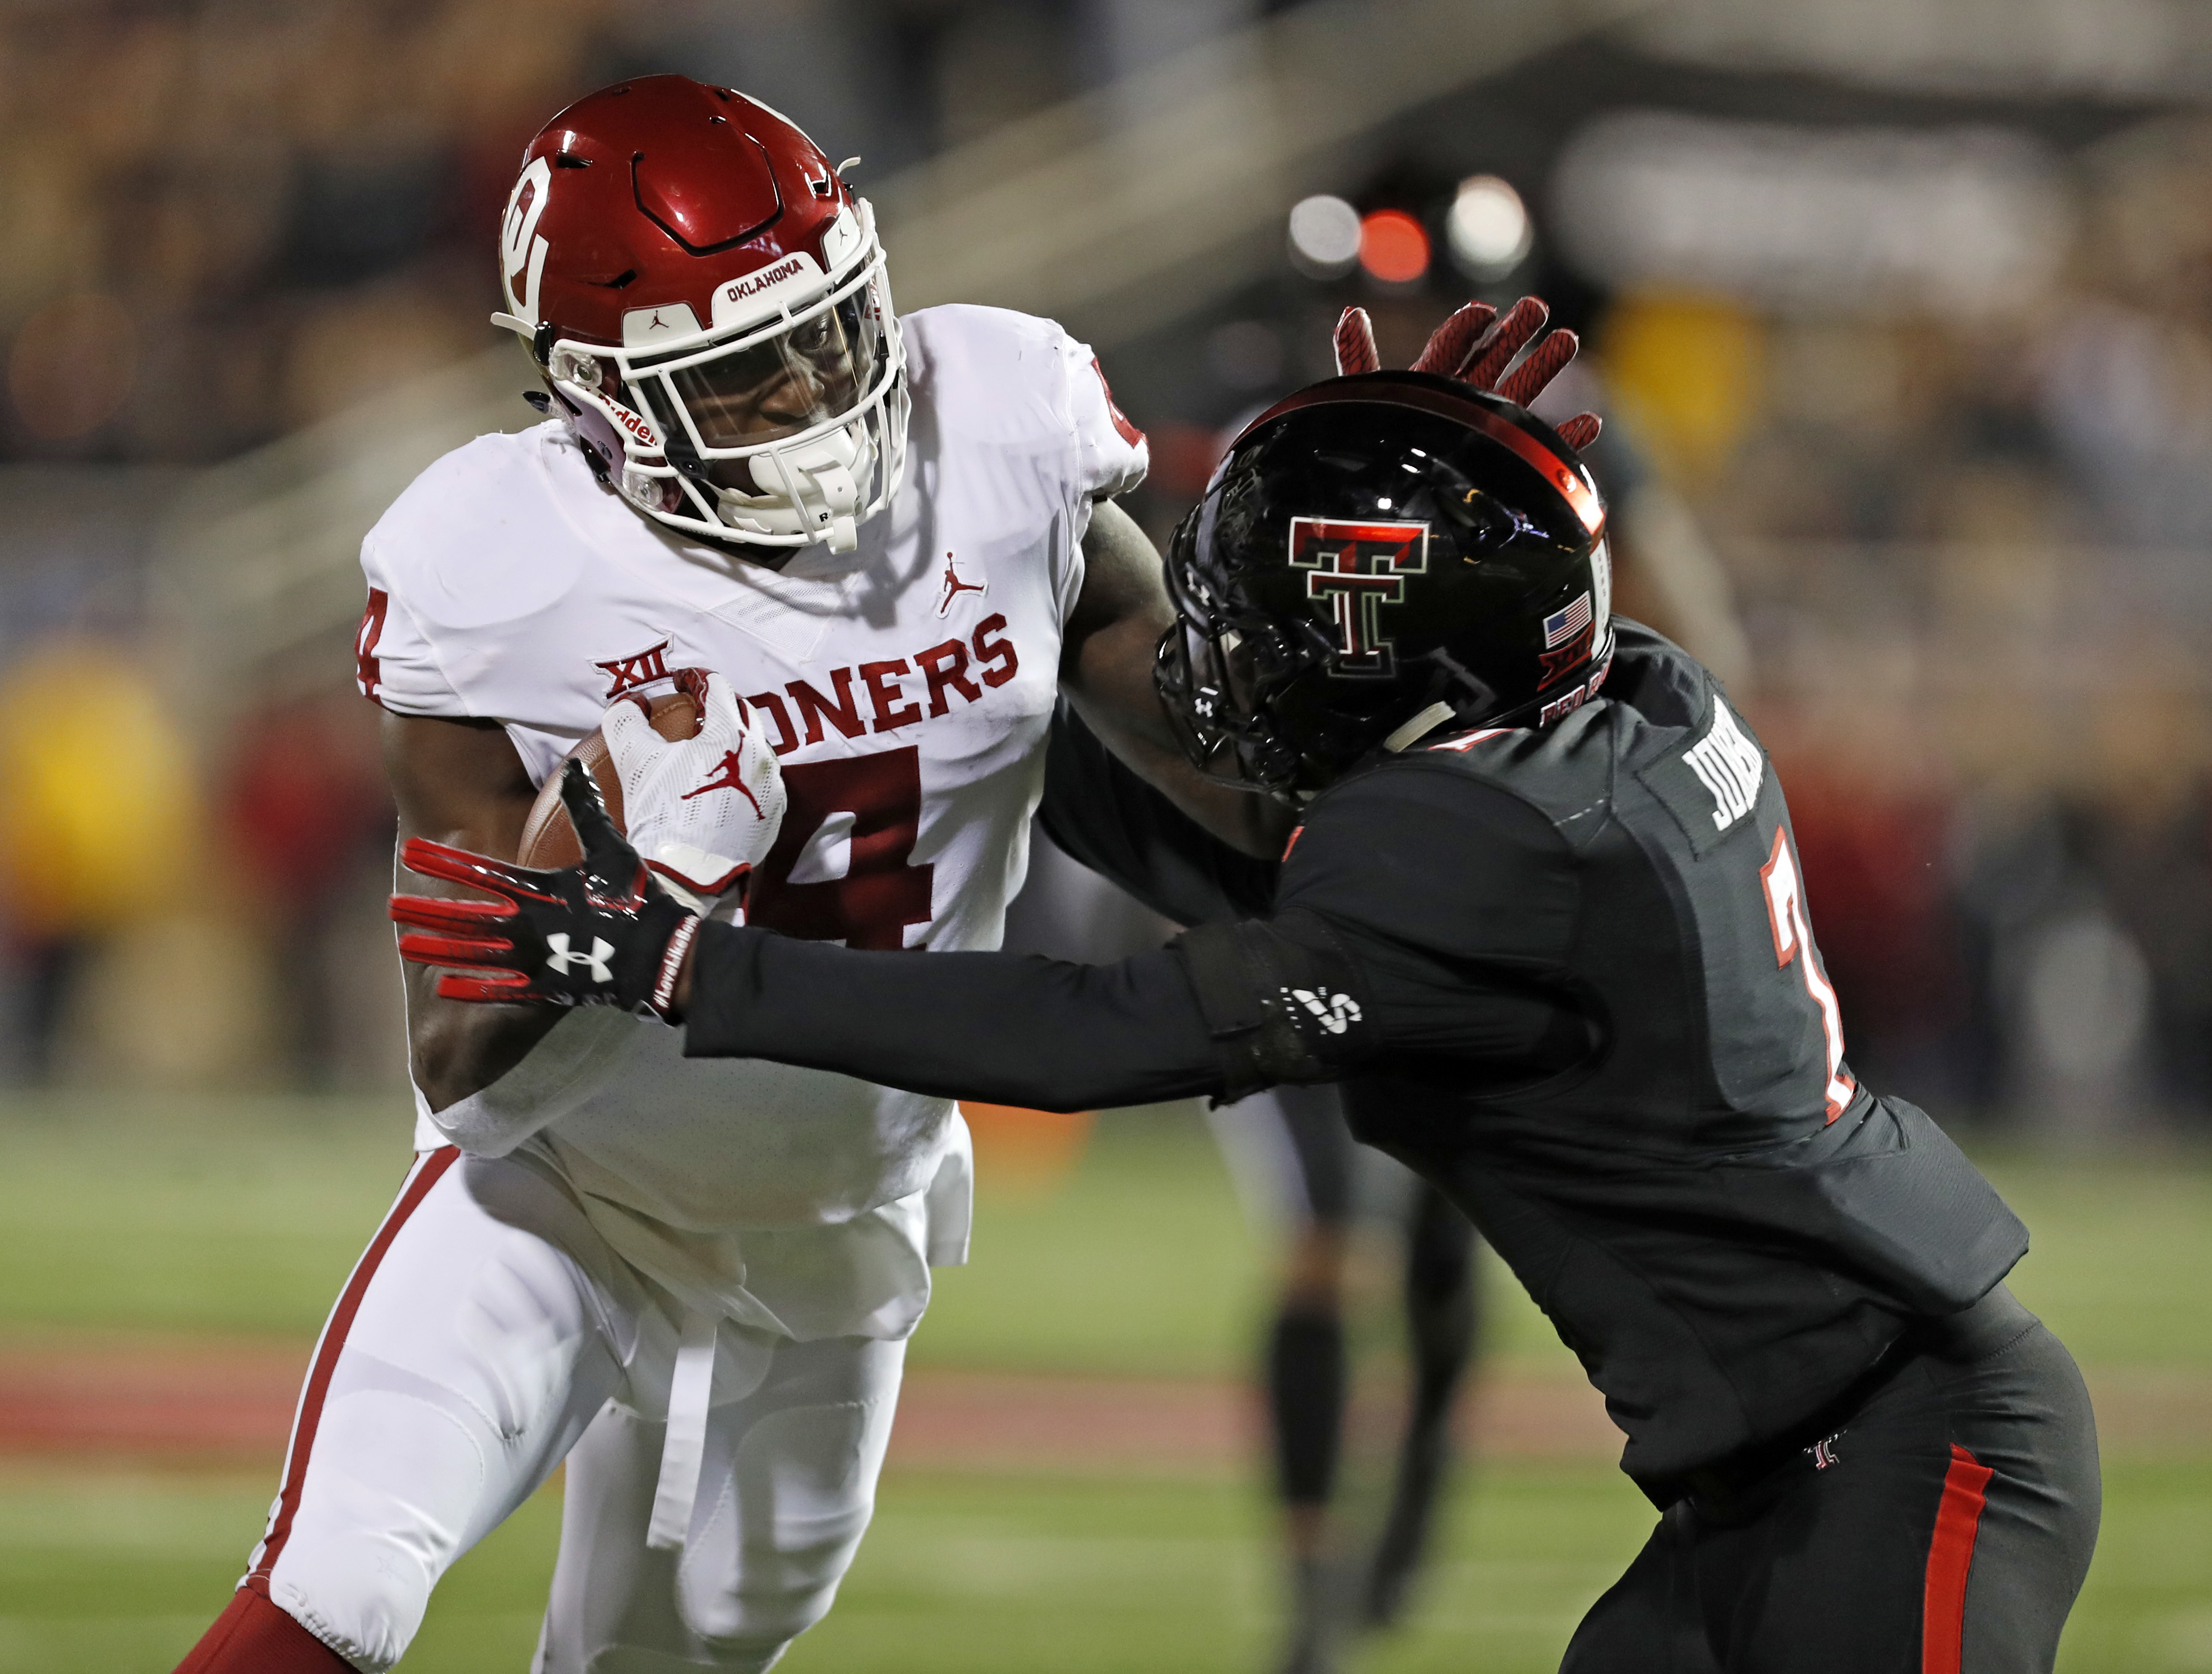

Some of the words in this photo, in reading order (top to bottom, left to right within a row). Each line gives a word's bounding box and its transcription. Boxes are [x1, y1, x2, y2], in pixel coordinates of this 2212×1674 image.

[727, 258, 804, 302] OKLAHOMA
[737, 612, 1019, 756] ONERS
[750, 744, 935, 952] 4
